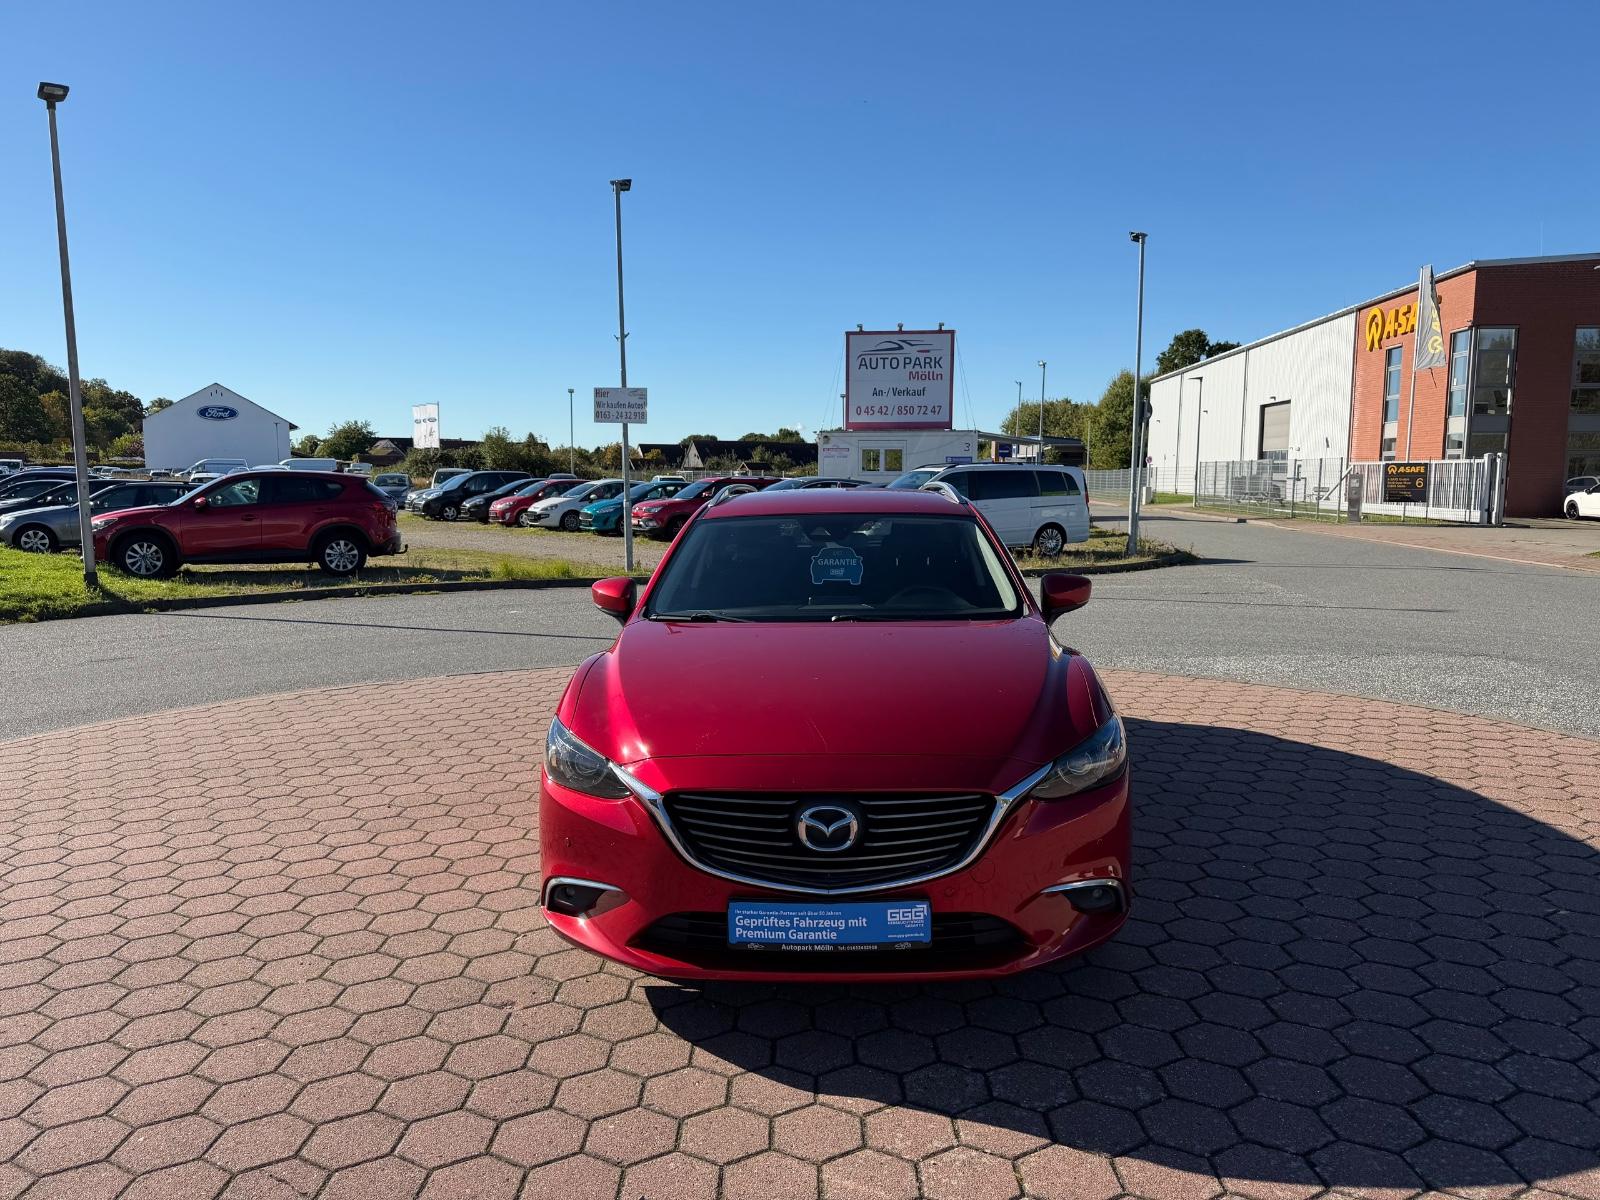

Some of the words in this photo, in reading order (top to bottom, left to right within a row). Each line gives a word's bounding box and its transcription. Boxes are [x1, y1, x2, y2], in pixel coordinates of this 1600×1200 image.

[858, 357, 900, 370] AUTO
[903, 356, 943, 370] PARK
[908, 371, 943, 380] Mölln
[596, 388, 609, 398] Hier
[892, 386, 926, 396] Verkauf
[206, 408, 230, 418] Ford
[596, 411, 610, 419] 0163
[856, 406, 862, 416] 0
[864, 406, 874, 416] 45
[878, 406, 888, 416] 42
[897, 406, 914, 416] 850
[917, 406, 928, 415] 72
[930, 406, 942, 415] 47
[1416, 478, 1424, 488] 6
[888, 908, 924, 921] GGG
[736, 916, 790, 928] Geprüftes
[794, 917, 845, 930] Fahrzeug
[848, 917, 867, 927] mit
[736, 928, 786, 939] Premium
[788, 929, 837, 940] Garantie
